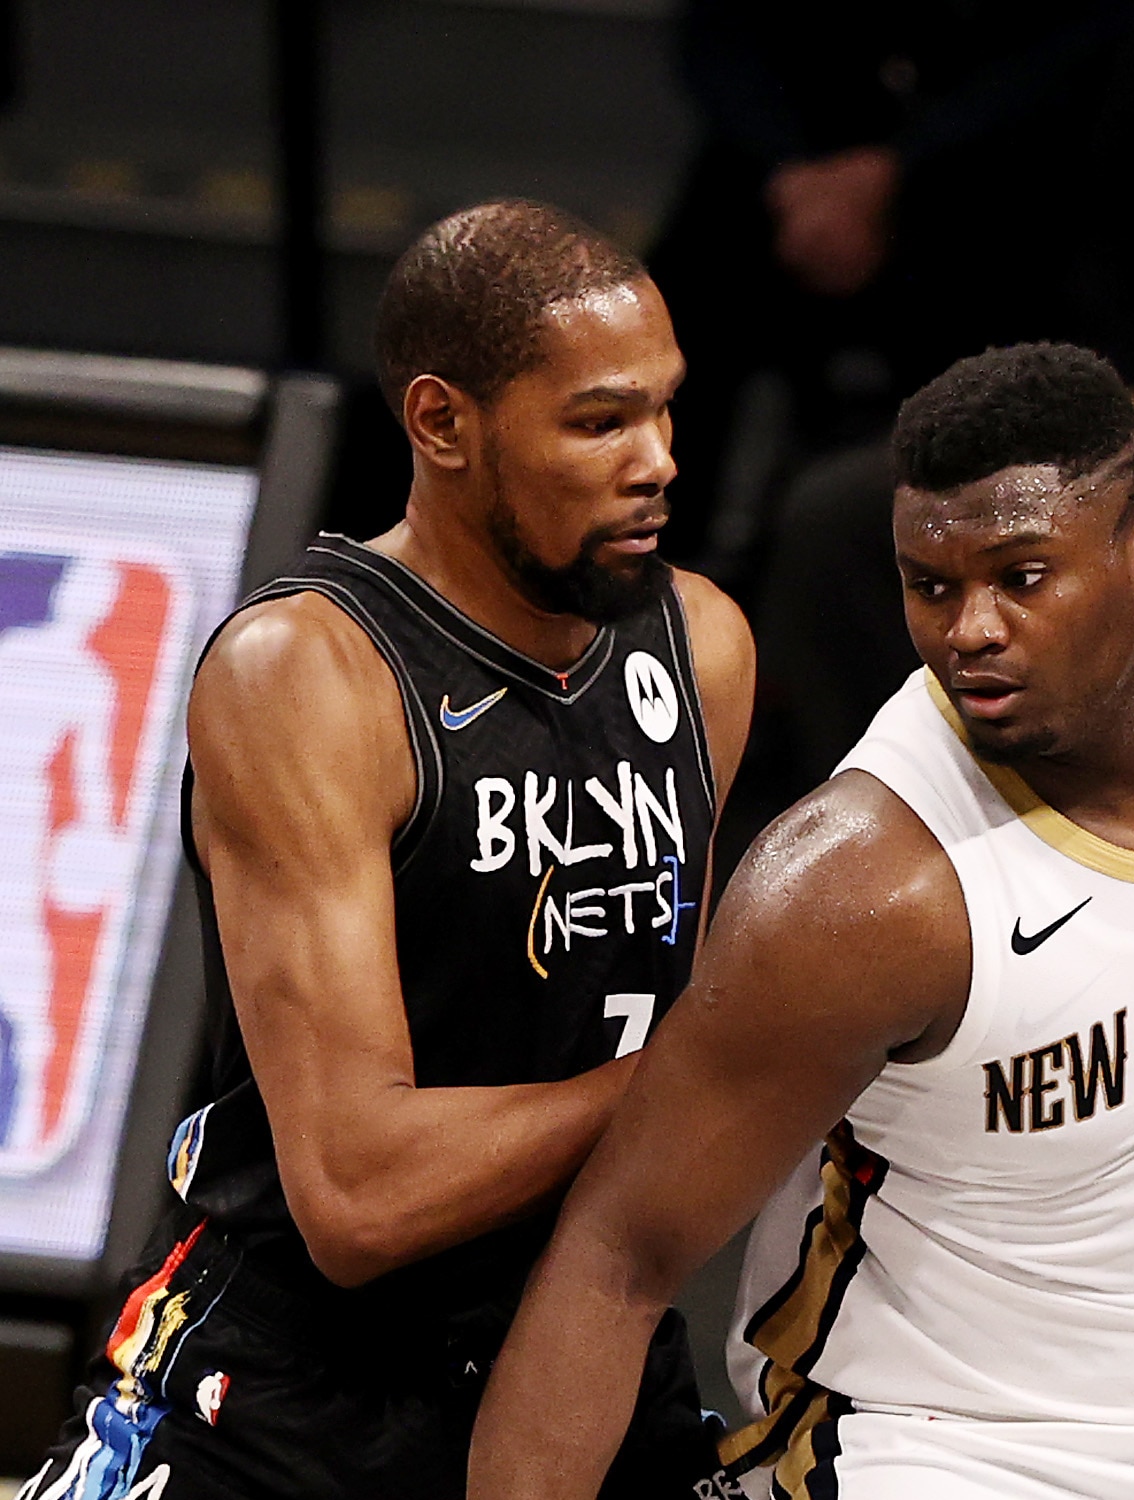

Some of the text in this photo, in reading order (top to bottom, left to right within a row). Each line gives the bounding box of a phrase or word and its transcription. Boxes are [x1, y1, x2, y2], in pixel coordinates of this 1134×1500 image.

[470, 761, 686, 876] BKLYN
[603, 993, 656, 1060] 7
[981, 1005, 1128, 1134] NEW
